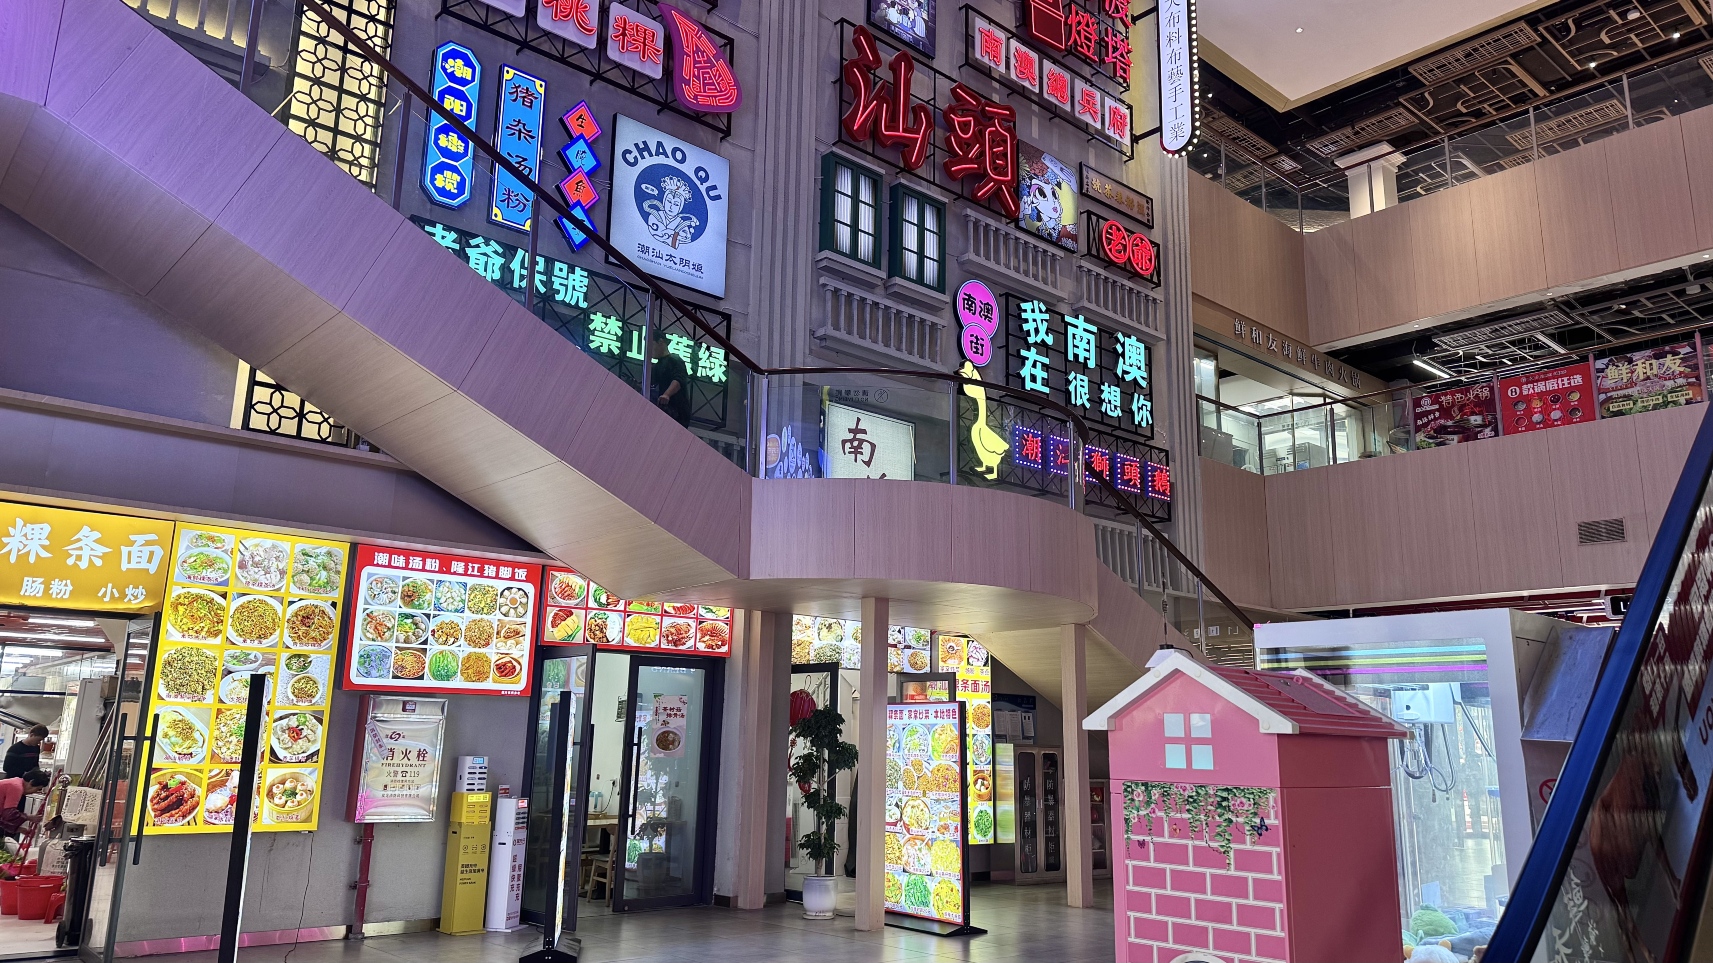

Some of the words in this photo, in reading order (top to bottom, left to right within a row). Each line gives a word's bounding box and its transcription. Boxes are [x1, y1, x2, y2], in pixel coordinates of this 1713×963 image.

[621, 140, 687, 167] CHAO
[693, 165, 723, 202] QU
[969, 333, 985, 357] 街
[1606, 353, 1690, 384] 鲜和友
[0, 517, 165, 575] 粿条面
[373, 552, 528, 581] 潮味汤粉、隆江猪脚饭
[20, 577, 74, 599] 肠粉
[97, 583, 147, 604] 小炒
